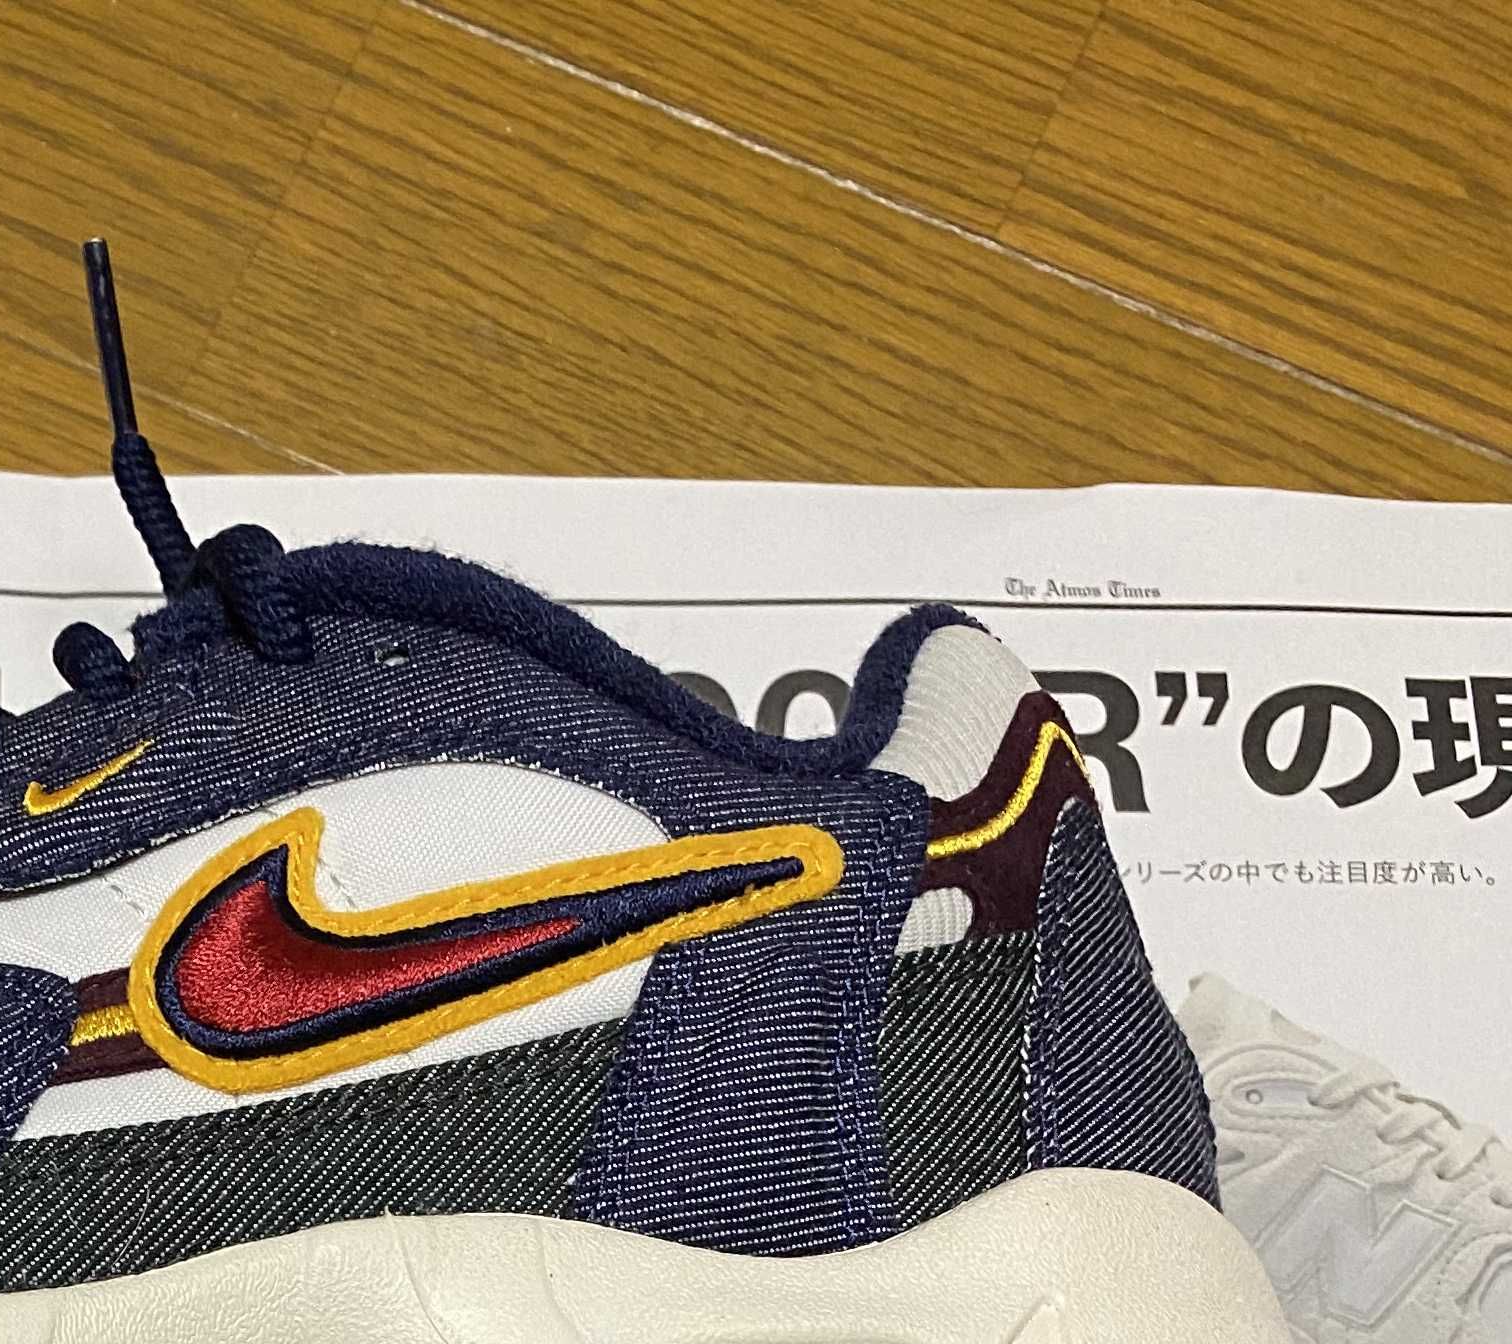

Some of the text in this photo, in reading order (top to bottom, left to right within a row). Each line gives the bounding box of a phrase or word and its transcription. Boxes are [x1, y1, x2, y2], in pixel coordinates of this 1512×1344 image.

[1004, 576, 1162, 600] The Atmos Times
